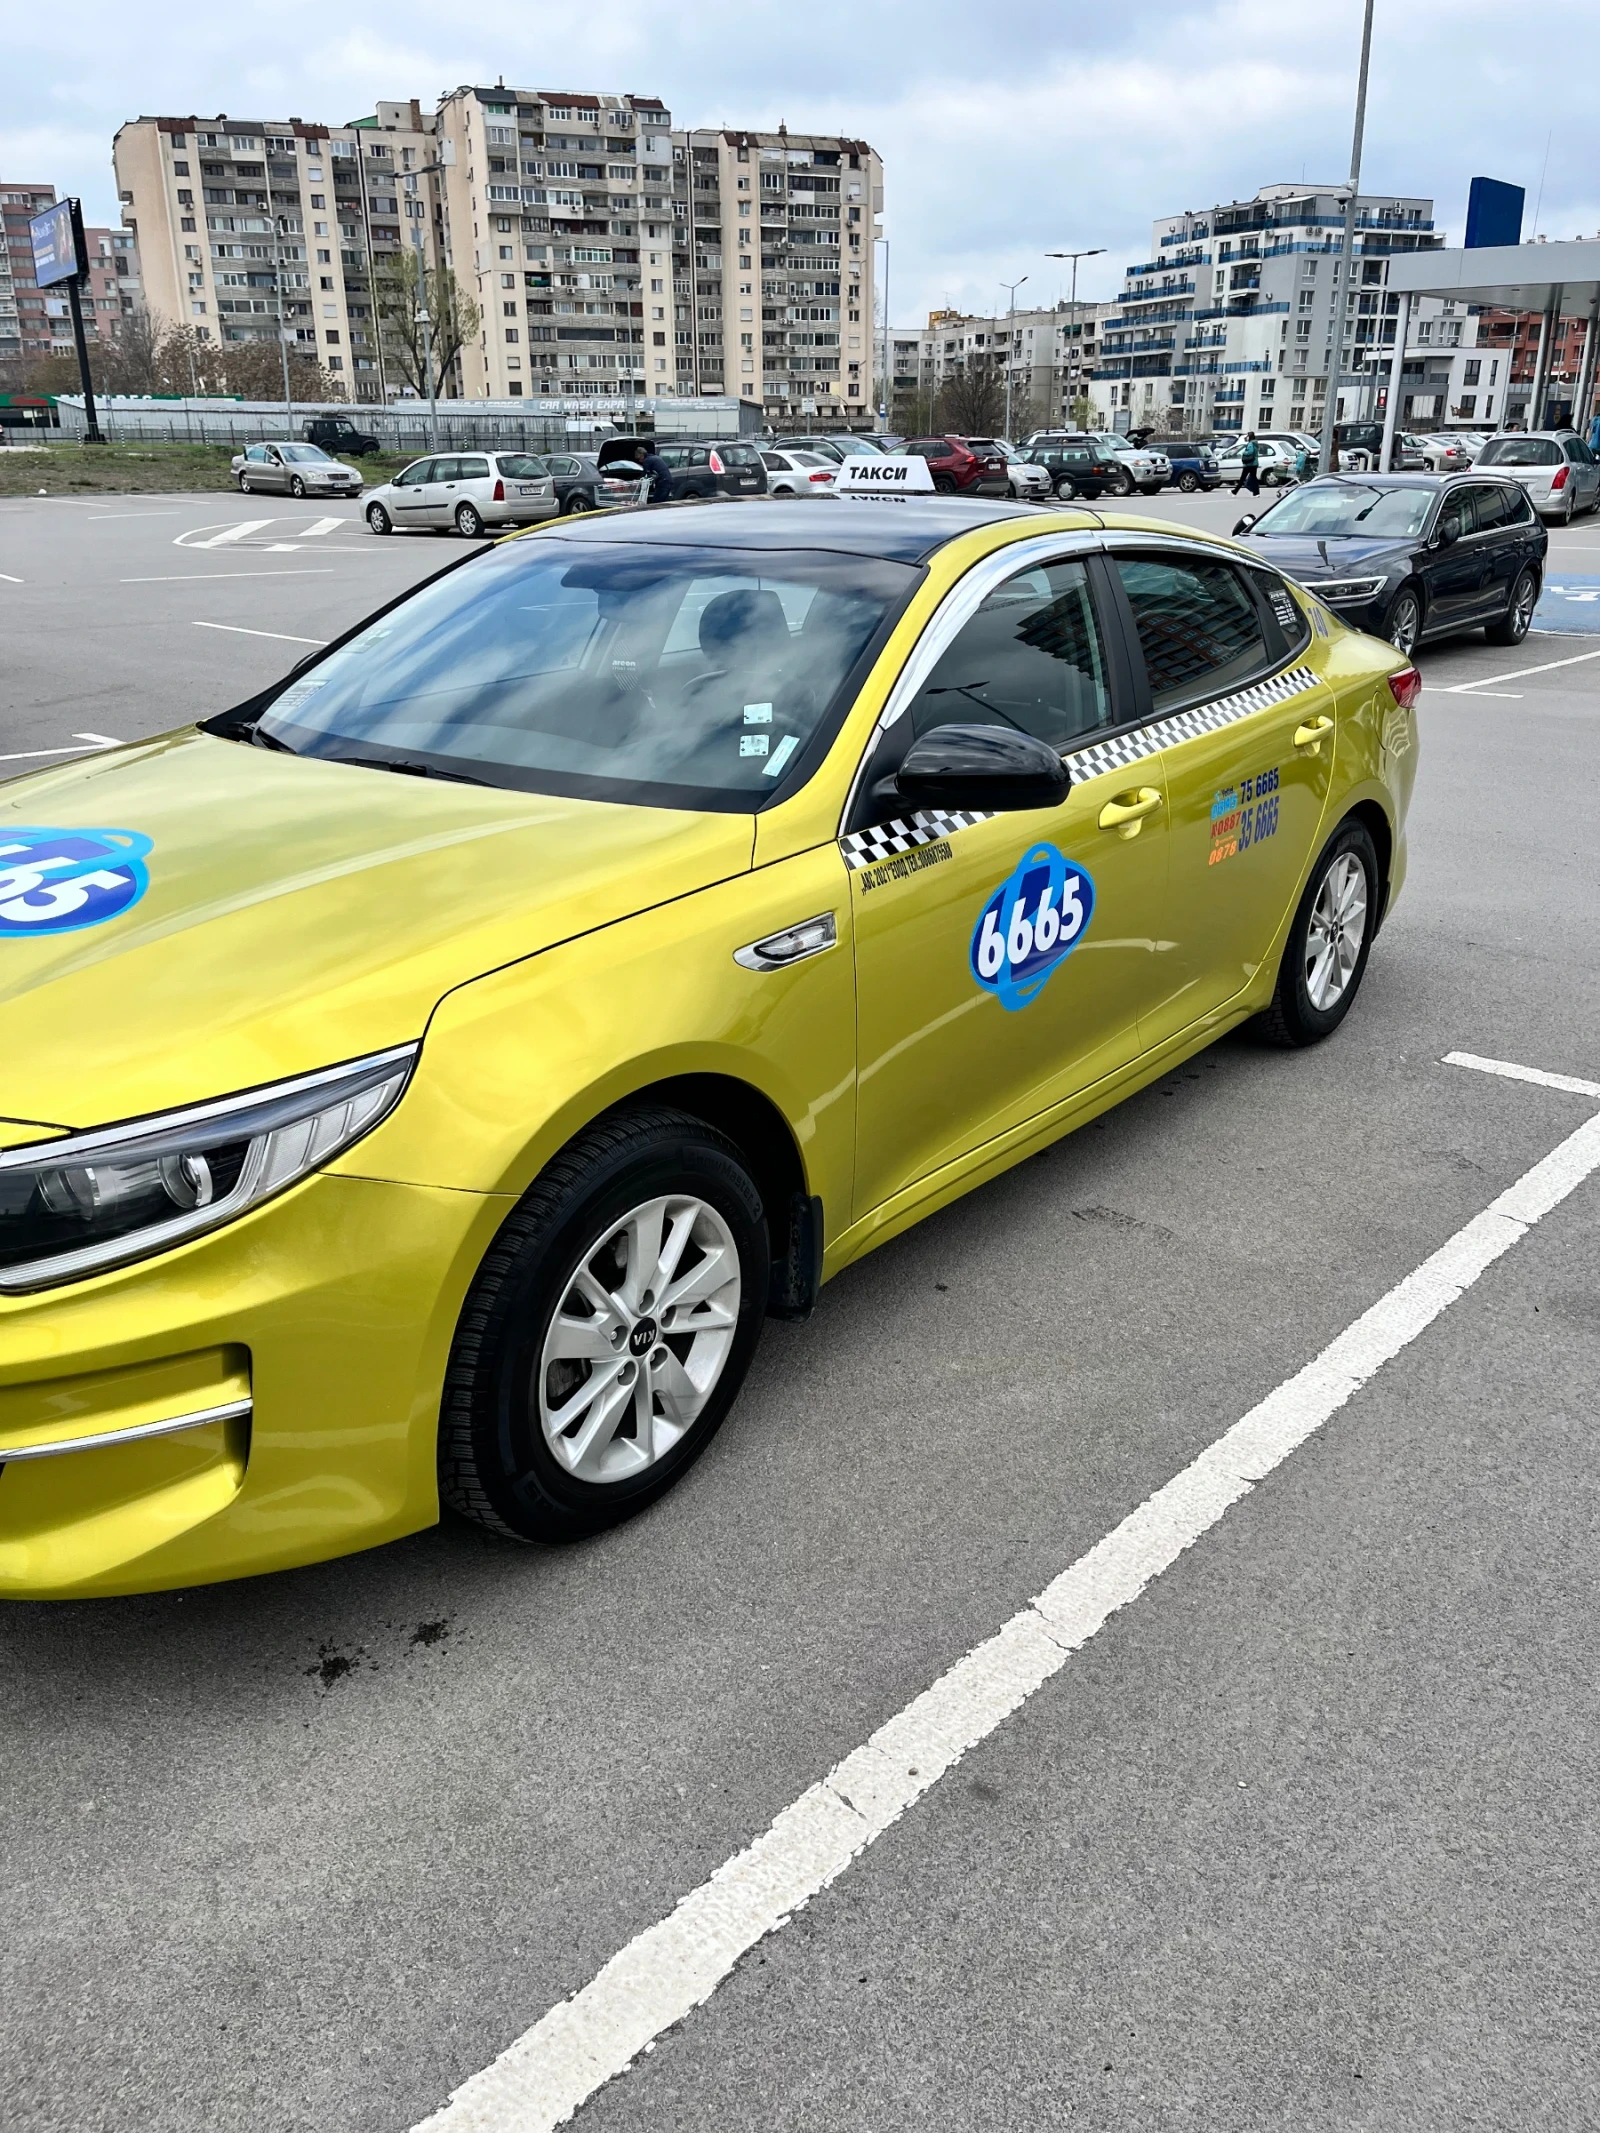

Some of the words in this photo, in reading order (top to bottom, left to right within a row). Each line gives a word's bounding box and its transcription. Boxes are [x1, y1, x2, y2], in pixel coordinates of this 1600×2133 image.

[539, 400, 560, 410] CAR
[563, 400, 593, 410] WASH
[849, 466, 908, 480] ТАКСИ
[612, 659, 636, 667] areon
[1240, 779, 1253, 805] 75
[1255, 767, 1280, 798] 6665
[1238, 807, 1254, 852] 35
[1254, 795, 1280, 844] 6665
[1208, 840, 1238, 866] 0878
[0, 844, 131, 922] 65
[978, 875, 1084, 978] 6665
